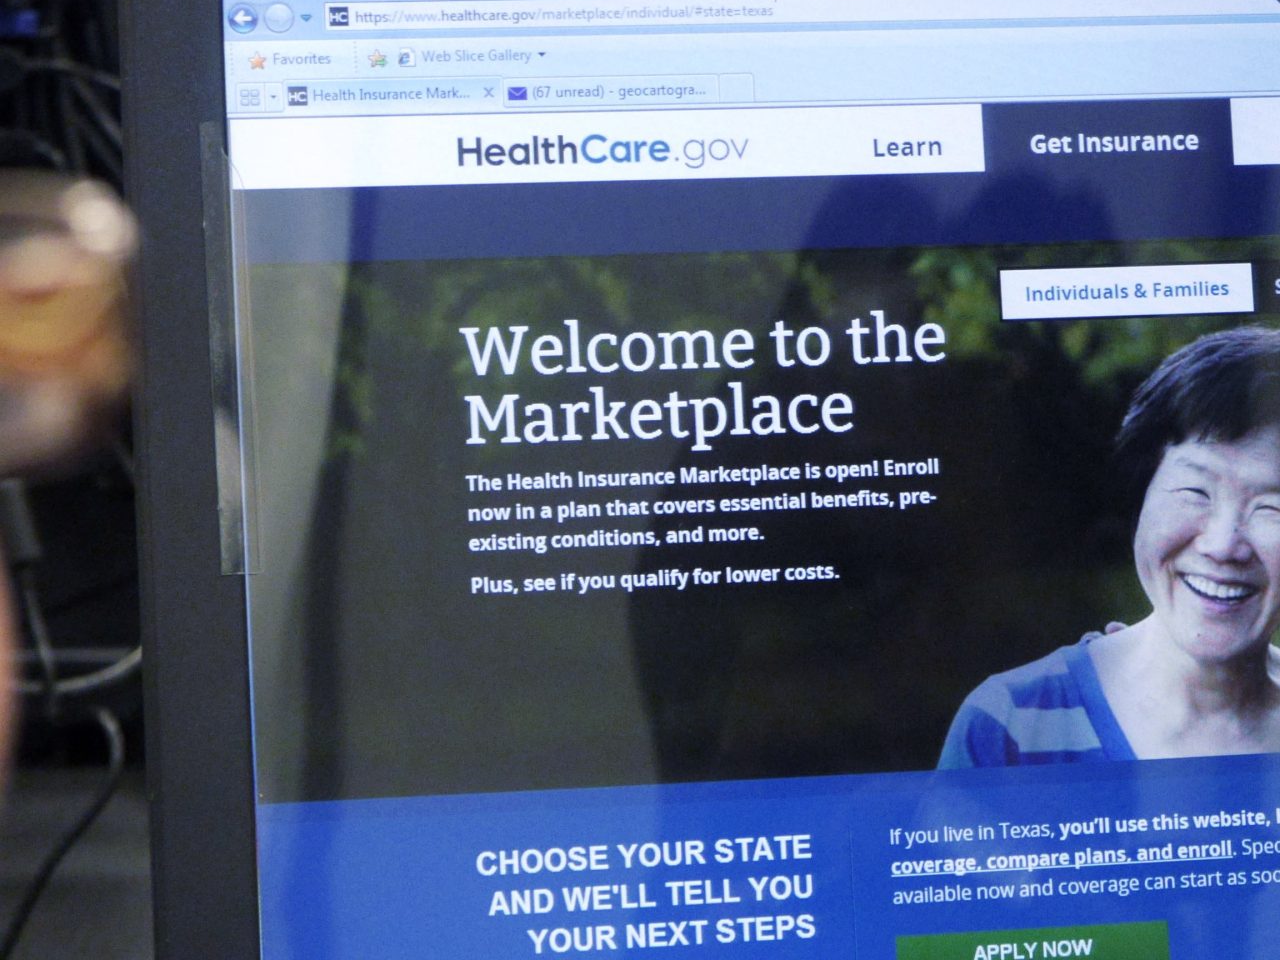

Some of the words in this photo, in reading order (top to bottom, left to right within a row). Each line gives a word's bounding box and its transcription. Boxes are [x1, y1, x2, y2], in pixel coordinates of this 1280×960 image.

[273, 52, 332, 66] Favorites
[422, 50, 451, 63] Web
[455, 49, 485, 62] Slice
[488, 48, 532, 65] Gallery
[313, 88, 356, 102] Health
[359, 88, 422, 101] Insurance
[426, 86, 471, 100] Mark...
[533, 85, 551, 101] (67
[555, 85, 604, 101] unread)
[618, 83, 706, 100] geocartogra...
[456, 133, 749, 169] HealthCare.gov
[873, 138, 943, 158] Learn
[1029, 132, 1073, 155] Get
[1078, 130, 1200, 153] Insurance
[1025, 281, 1128, 303] Individuals
[1133, 281, 1148, 299] &
[1152, 279, 1230, 298] Families
[459, 318, 755, 376] Welcome
[769, 320, 831, 368] to
[845, 310, 946, 365] the
[464, 381, 855, 452] Marketplace
[465, 474, 503, 492] The
[506, 472, 573, 491] Health
[578, 469, 676, 488] Insurance
[680, 464, 800, 486] Marketplace
[805, 462, 821, 479] is
[825, 460, 879, 483] open!
[884, 457, 940, 477] Enroll
[468, 506, 511, 522] now
[515, 503, 535, 520] in
[540, 506, 553, 519] a
[557, 501, 601, 523] plan
[606, 499, 649, 517] that
[653, 499, 715, 514] covers
[720, 492, 806, 513] essential
[811, 490, 895, 509] benefits,
[899, 490, 937, 510] pre-
[468, 534, 548, 554] existing
[551, 529, 661, 549] conditions,
[665, 526, 703, 544] and
[708, 527, 765, 542] more.
[470, 576, 518, 595] Plus,
[523, 576, 556, 592] see
[561, 573, 576, 590] if
[578, 575, 616, 595] you
[620, 568, 690, 593] qualify
[693, 567, 722, 584] for
[726, 566, 781, 584] lower
[784, 565, 841, 581] costs.
[889, 828, 901, 846] If
[904, 829, 939, 849] you
[943, 826, 973, 843] live
[978, 824, 995, 841] in
[999, 822, 1056, 840] Texas,
[1059, 817, 1110, 839] you’ll
[1115, 817, 1148, 833] use
[1153, 813, 1189, 831] this
[1193, 809, 1271, 829] website,
[475, 845, 610, 876] CHOOSE
[617, 840, 706, 868] YOUR
[714, 835, 813, 864] STATE
[891, 855, 982, 876] coverage,
[986, 849, 1070, 872] compare
[1074, 847, 1132, 869] plans,
[1136, 844, 1173, 862] and
[1177, 839, 1236, 860] enroll.
[488, 888, 555, 916] AND
[562, 882, 656, 913] WE'LL
[666, 878, 741, 907] TELL
[748, 874, 814, 902] YOU
[893, 884, 972, 905] available
[977, 883, 1015, 900] now
[1019, 879, 1054, 897] and
[1058, 875, 1139, 897] coverage
[1144, 874, 1176, 890] can
[1181, 871, 1222, 887] start
[1227, 870, 1247, 886] as
[527, 925, 618, 954] YOUR
[625, 920, 709, 948] NEXT
[715, 914, 816, 944] STEPS
[974, 942, 1038, 960] APPLY
[1042, 938, 1093, 957] NOW
